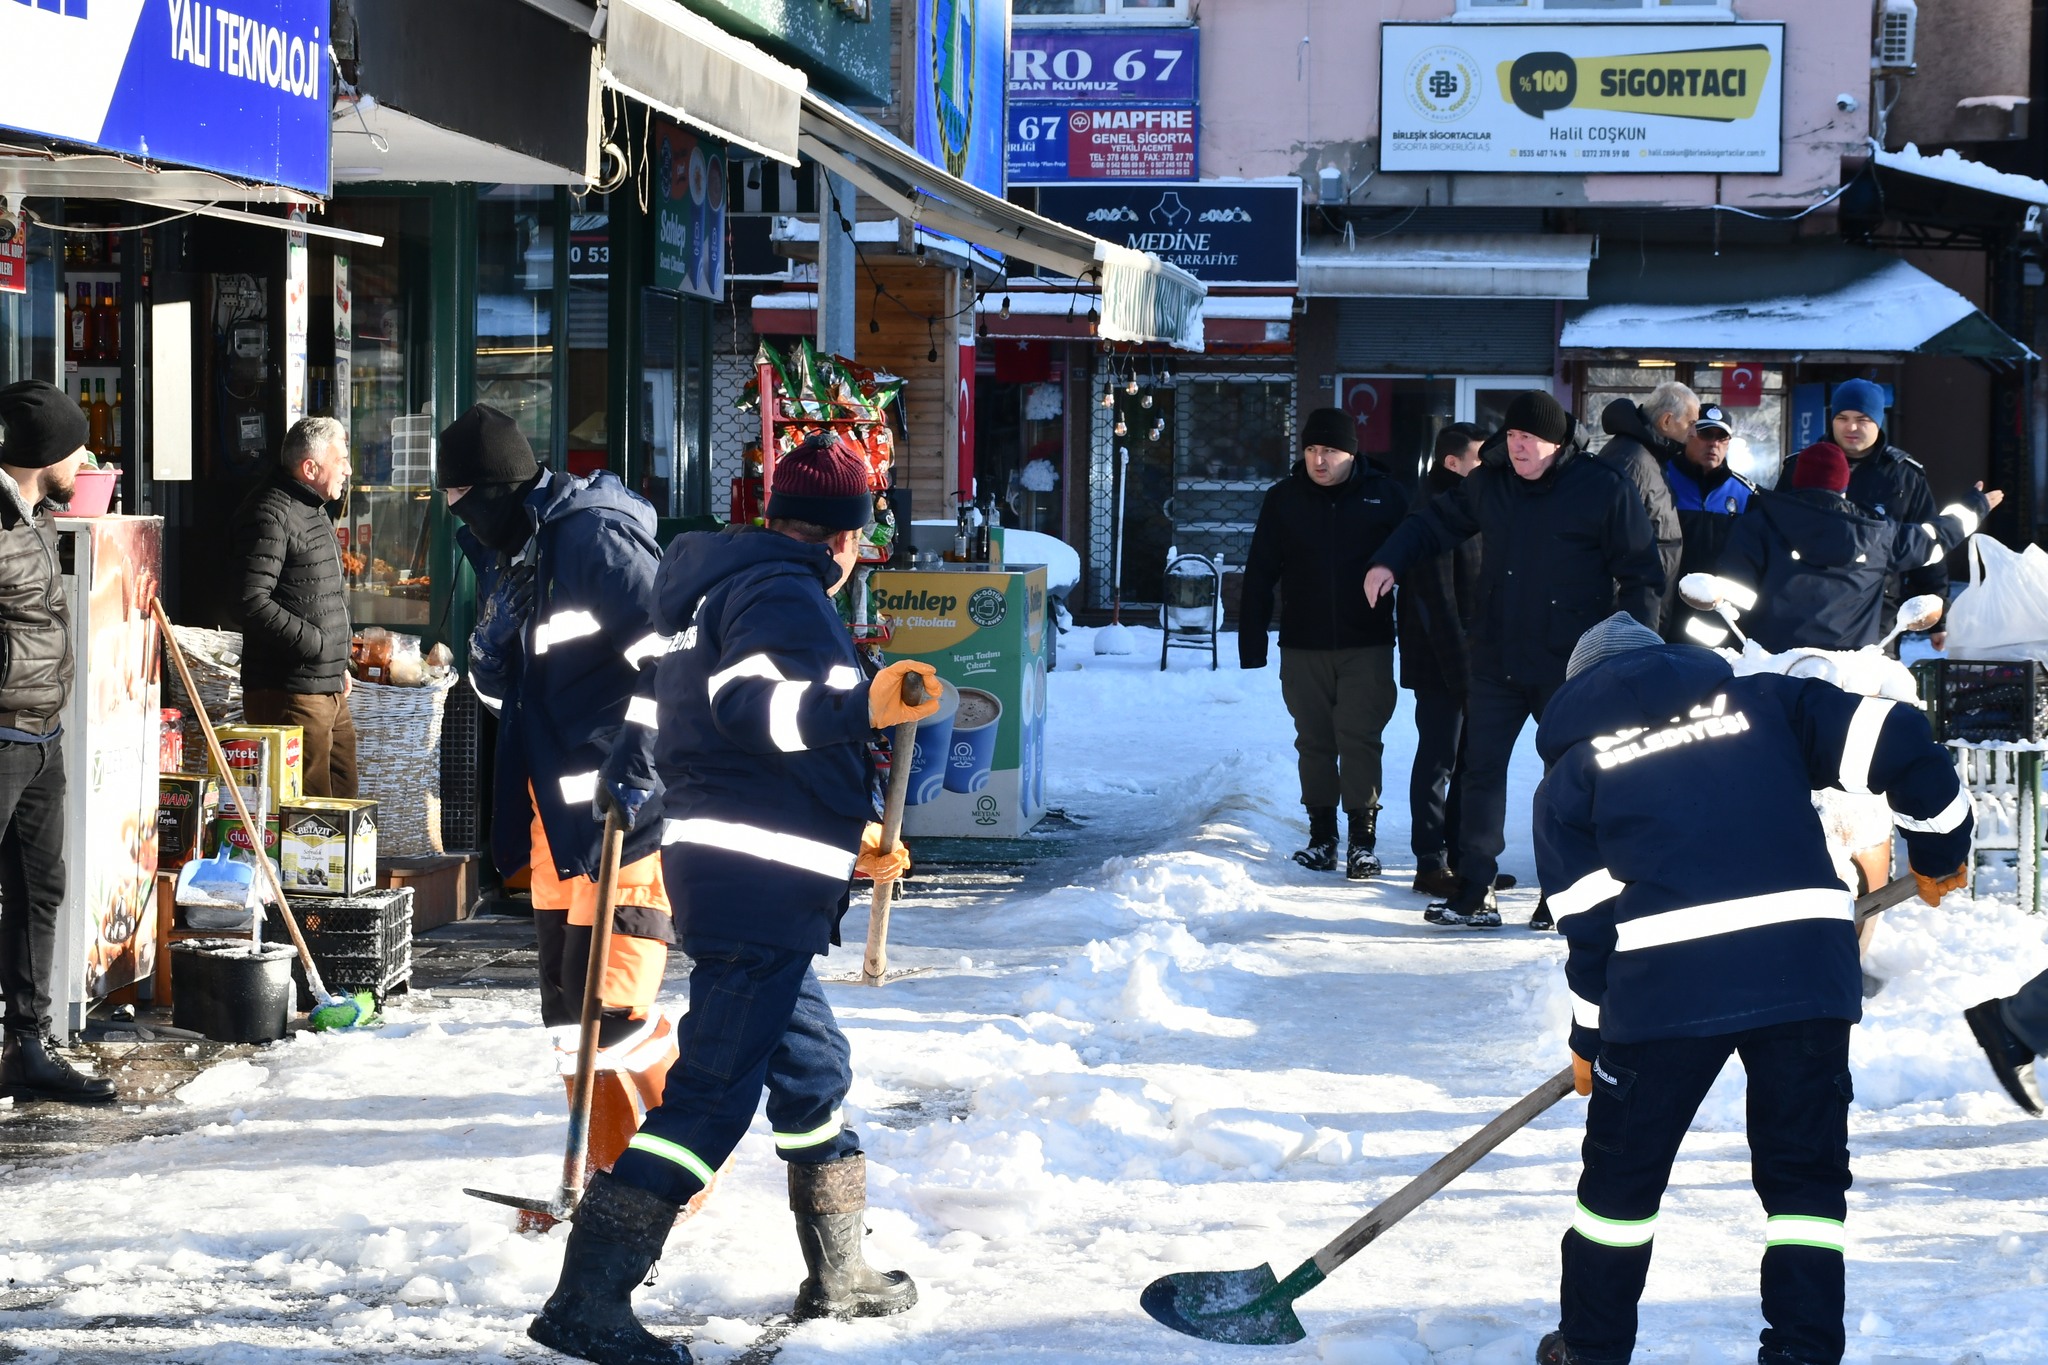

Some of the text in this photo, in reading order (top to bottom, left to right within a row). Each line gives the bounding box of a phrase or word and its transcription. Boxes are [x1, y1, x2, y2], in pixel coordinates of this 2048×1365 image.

[168, 0, 319, 100] YALI TEKNOLOJİ
[1113, 49, 1183, 81] 67
[1052, 81, 1118, 91] KUMUZ
[1519, 69, 1568, 92] %100
[1092, 111, 1192, 129] MAPFRE
[1018, 116, 1061, 141] 67
[1550, 126, 1646, 143] Halil COŞKUN
[1092, 131, 1192, 144] GENEL SİGORTA
[1392, 130, 1491, 141] BİRLEŞİK SİGORTACILAR
[1111, 144, 1140, 152] YETKİLİ
[1392, 142, 1427, 151] SİGORTA
[1089, 153, 1105, 161] TEL:
[1107, 153, 1119, 161] 378
[1144, 153, 1160, 161] FAX:
[1175, 153, 1184, 161] 27
[1185, 153, 1194, 161] 70
[660, 209, 686, 256] Sahlep
[1127, 228, 1211, 251] MEDİNE
[871, 589, 957, 616] Sahlep
[907, 616, 957, 631] Çikolata
[972, 614, 1004, 627] TAKE-AWAY
[953, 651, 1000, 663] Kışın Tadını
[966, 660, 990, 672] Çıkar!
[159, 816, 178, 829] Zeytin
[296, 824, 333, 837] BEYAZIT
